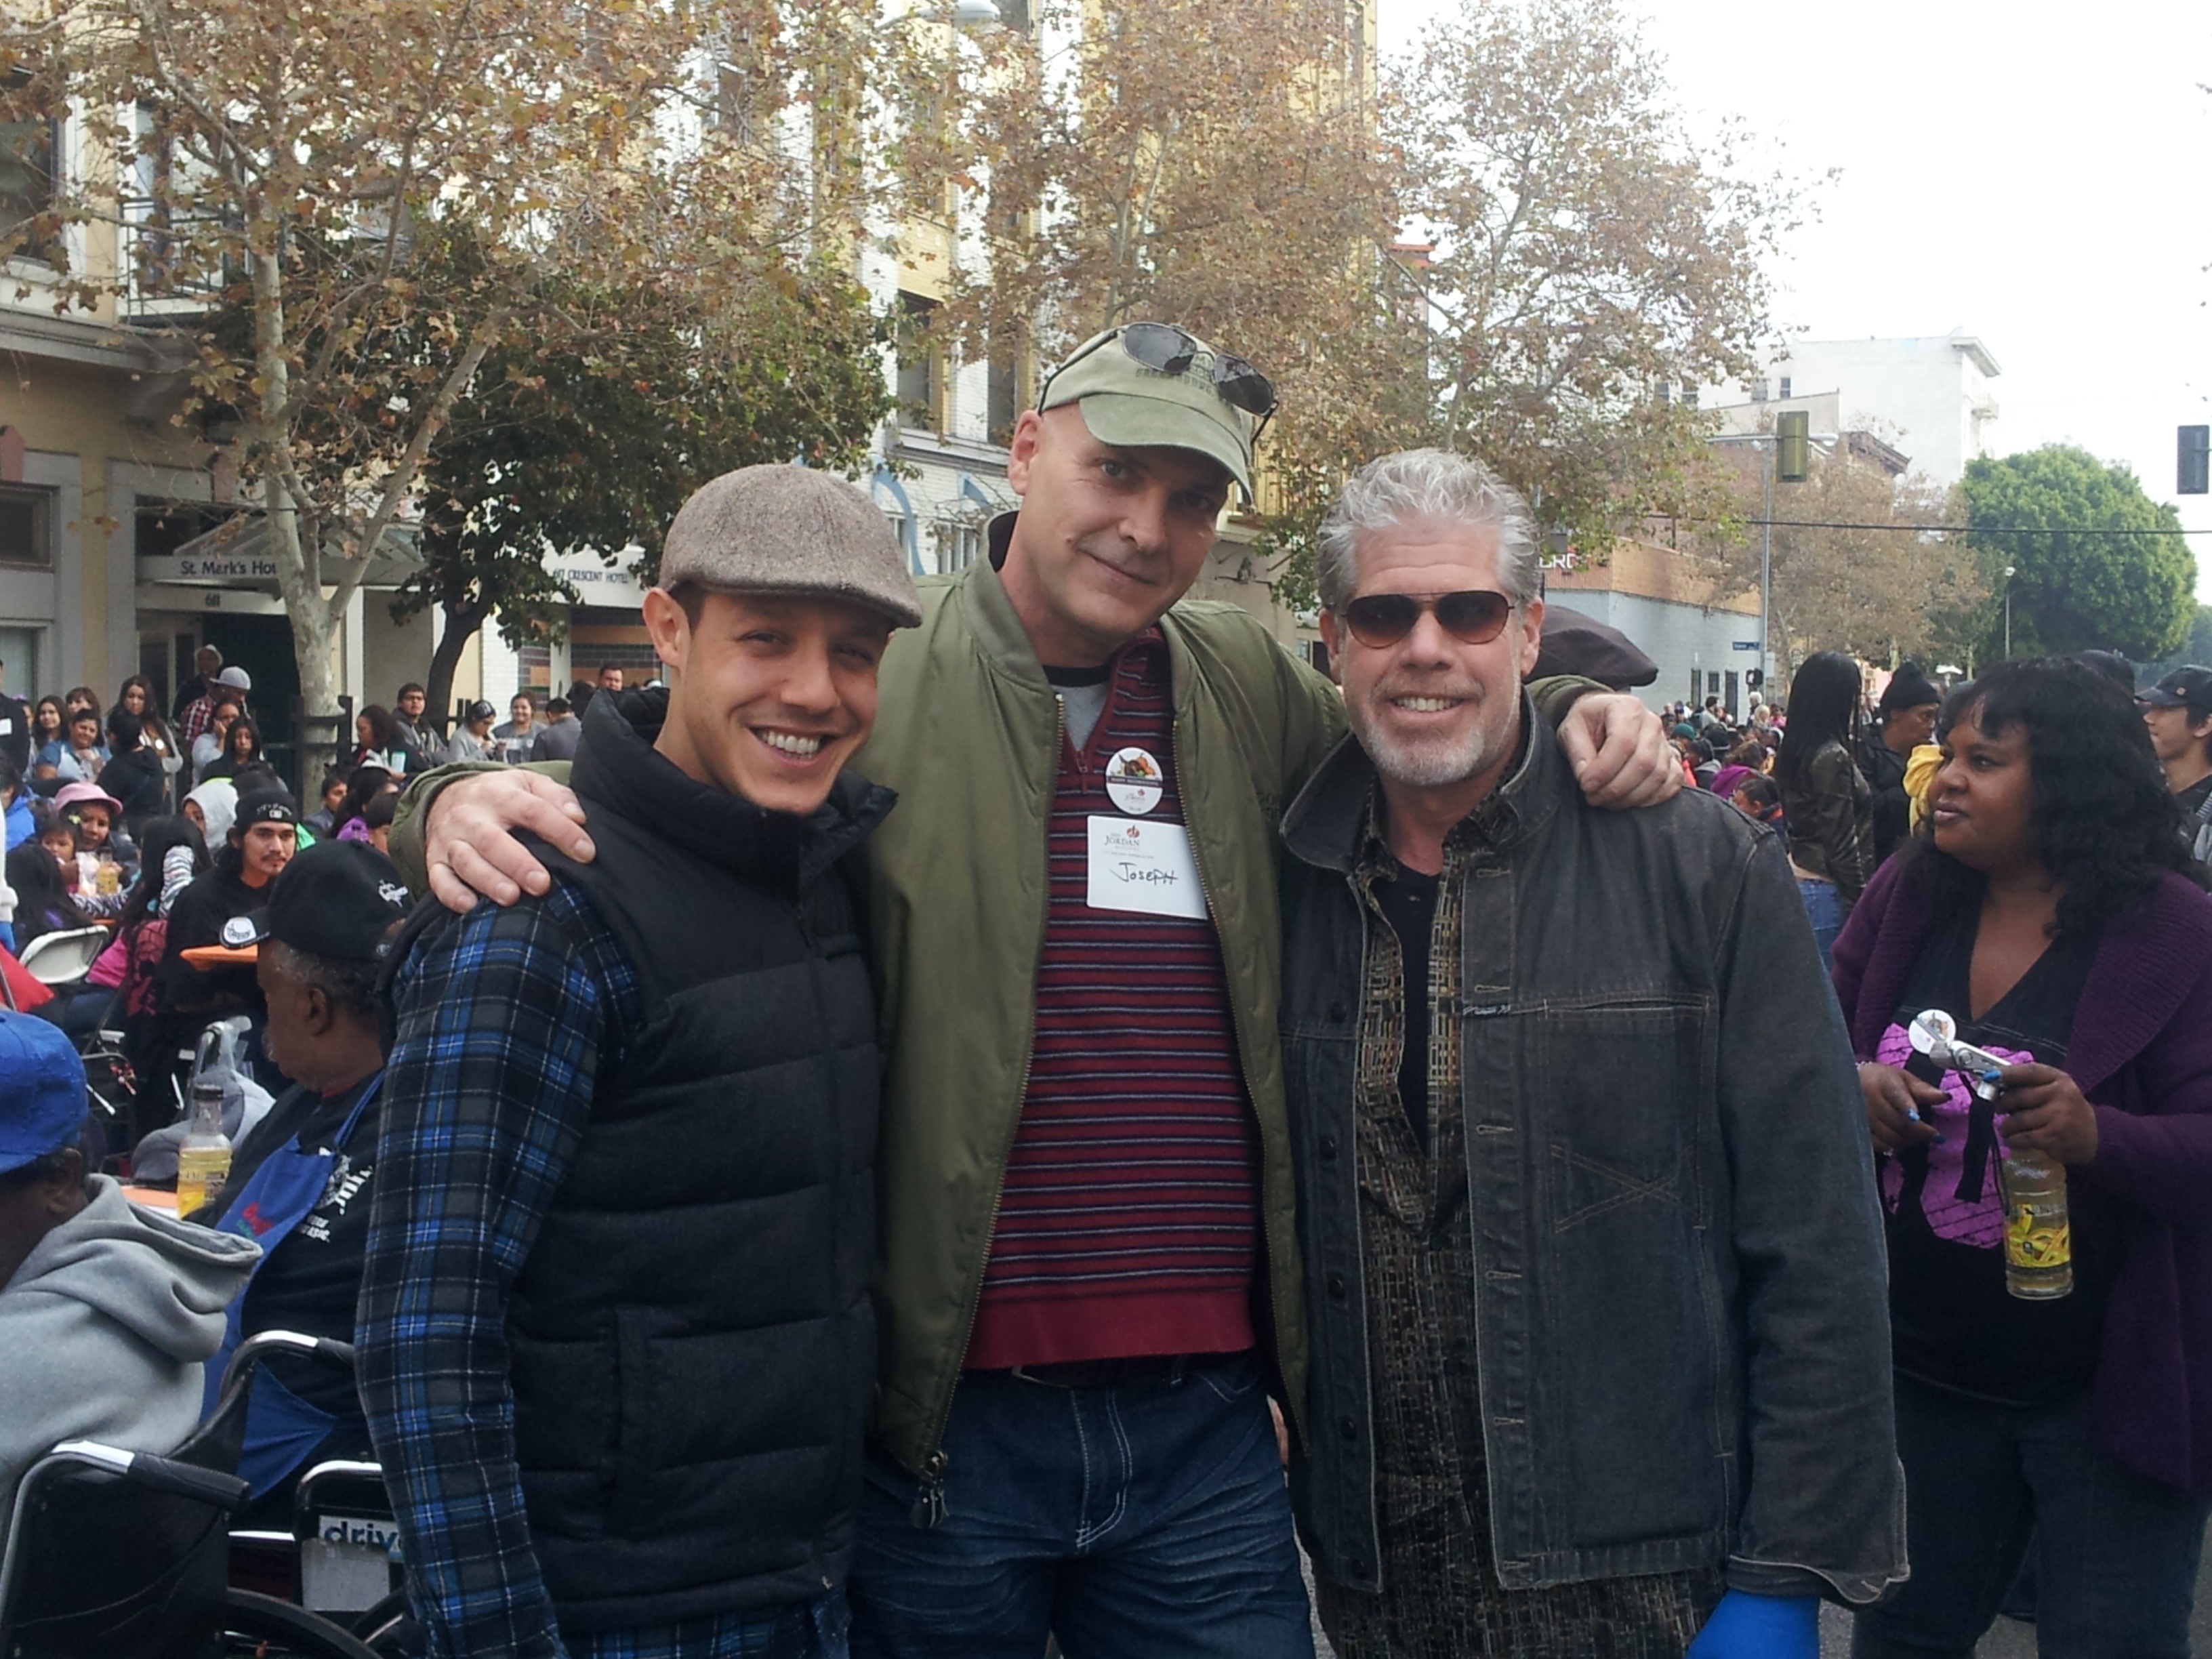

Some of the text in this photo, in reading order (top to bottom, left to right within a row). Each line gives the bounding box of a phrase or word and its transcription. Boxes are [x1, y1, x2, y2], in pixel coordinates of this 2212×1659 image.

[202, 560, 247, 575] Mark's
[567, 569, 602, 581] CRESCENT
[606, 573, 629, 583] HOTEL
[1104, 834, 1140, 846] JORDAN
[324, 1521, 401, 1552] driv
